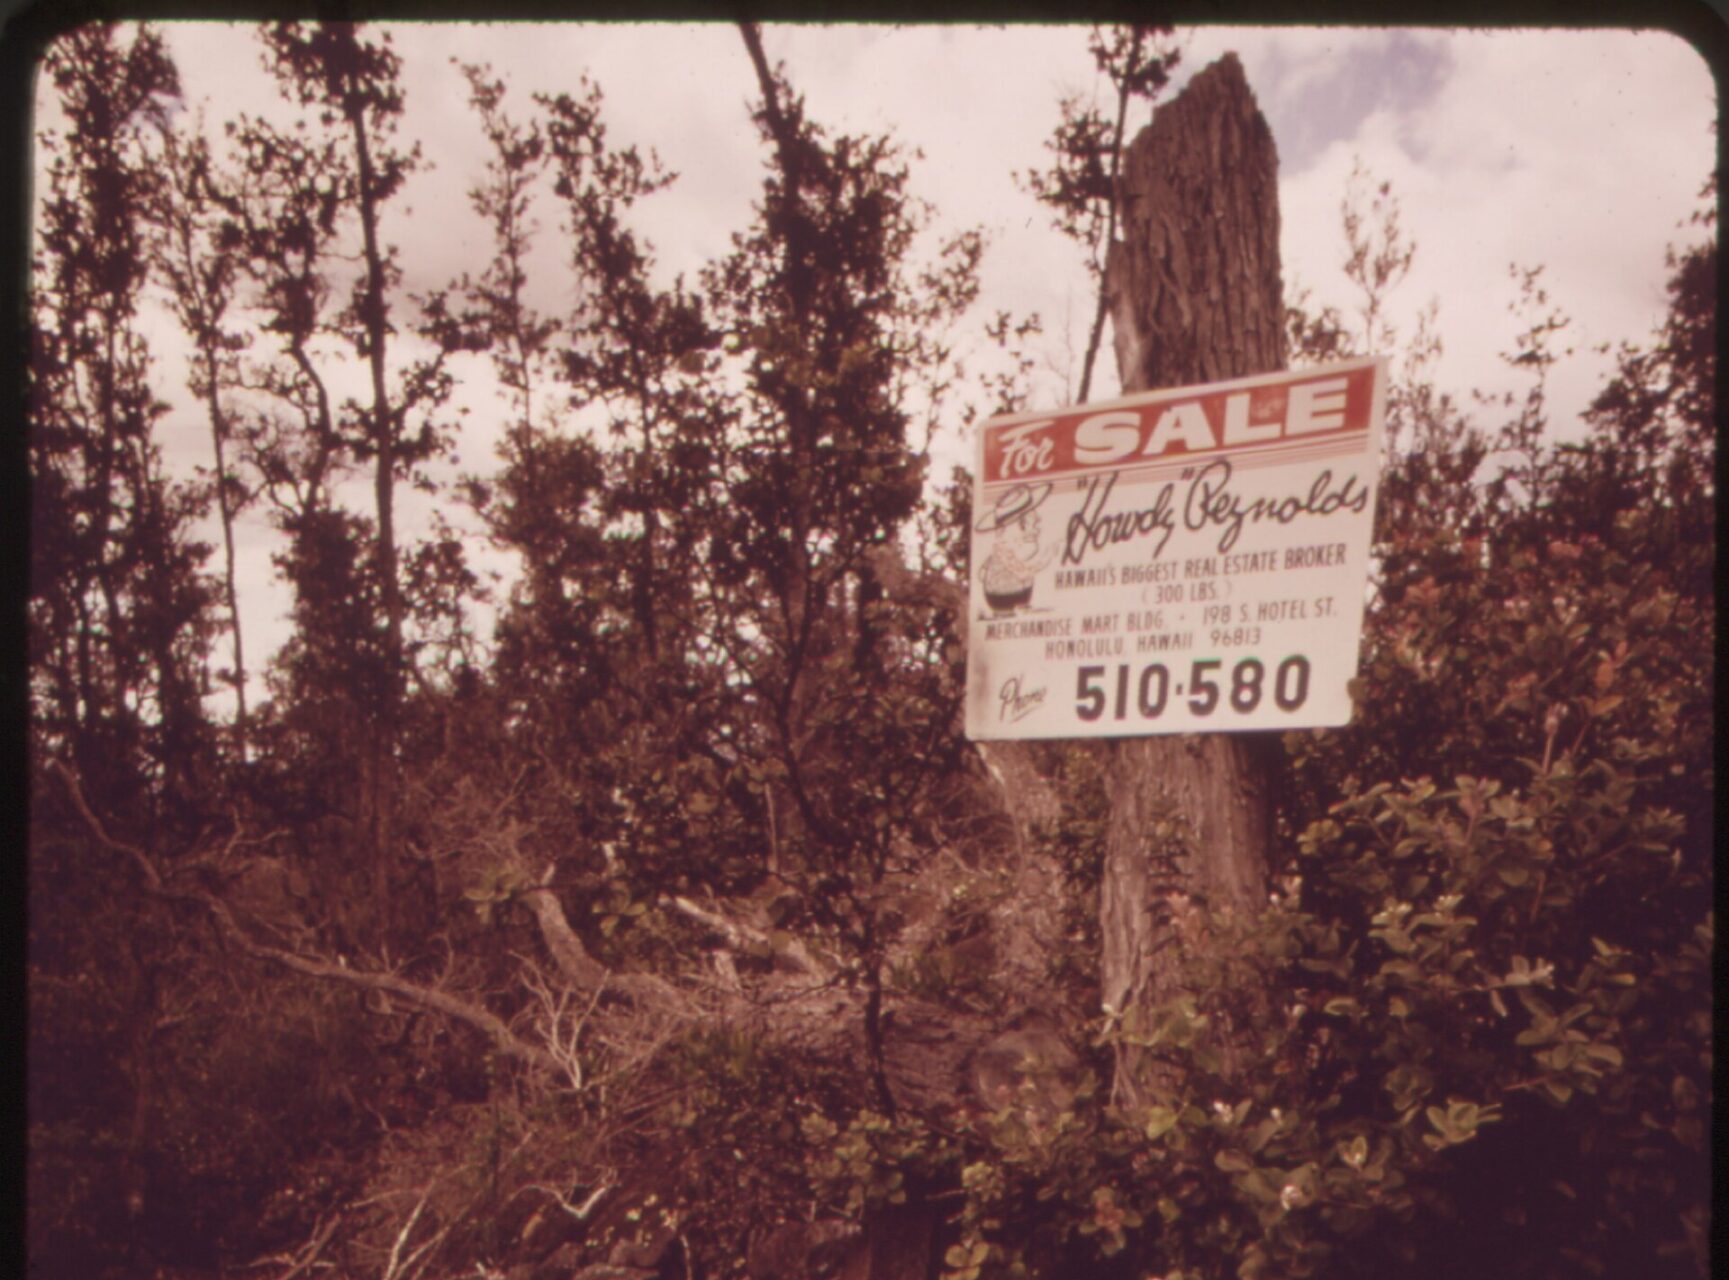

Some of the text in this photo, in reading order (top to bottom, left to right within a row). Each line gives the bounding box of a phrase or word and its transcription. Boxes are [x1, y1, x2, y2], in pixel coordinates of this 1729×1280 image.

[998, 377, 1348, 479] For SALE
[1183, 459, 1369, 554] Reynolds
[1055, 542, 1347, 591] HAWAII'S BIGGEST REAL ESTATE BROKER
[984, 617, 1073, 641] MERCHANDISE
[1081, 613, 1120, 635] MART
[1202, 604, 1232, 625] 198
[1257, 599, 1308, 623] HOTEL
[1136, 632, 1194, 654] HAWAII
[1210, 626, 1262, 648] 96813
